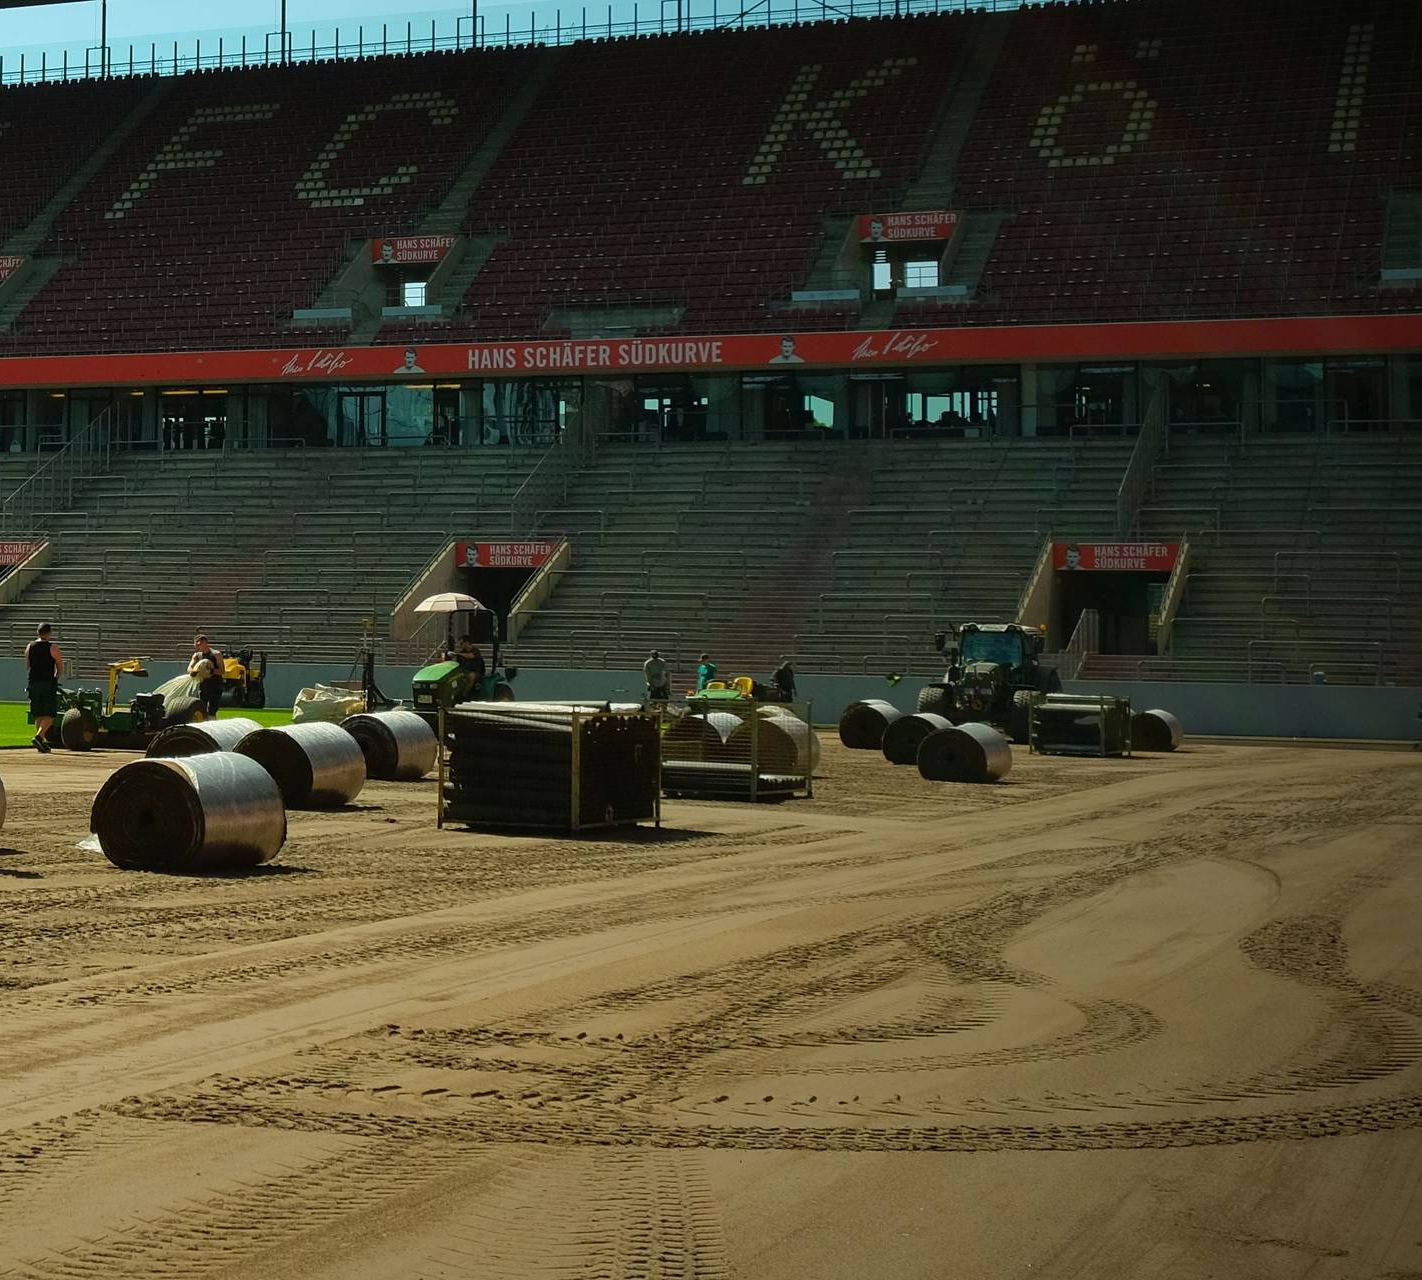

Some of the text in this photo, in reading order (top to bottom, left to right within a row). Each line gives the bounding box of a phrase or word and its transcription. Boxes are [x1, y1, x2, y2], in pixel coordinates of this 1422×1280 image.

[888, 212, 956, 226] HANS SCHÄFER
[887, 226, 937, 239] SÜDKURVE
[396, 239, 418, 250] HANS
[396, 249, 439, 261] SÜDKURVE
[468, 340, 723, 370] HANS SCHÄFER SÜDKURVE
[489, 543, 551, 556] HANS SCHÄFER
[1094, 544, 1168, 557] HANS SCHÄFER
[489, 554, 533, 566] SÜDKURVE
[1094, 557, 1147, 569] SÜDKURVE
